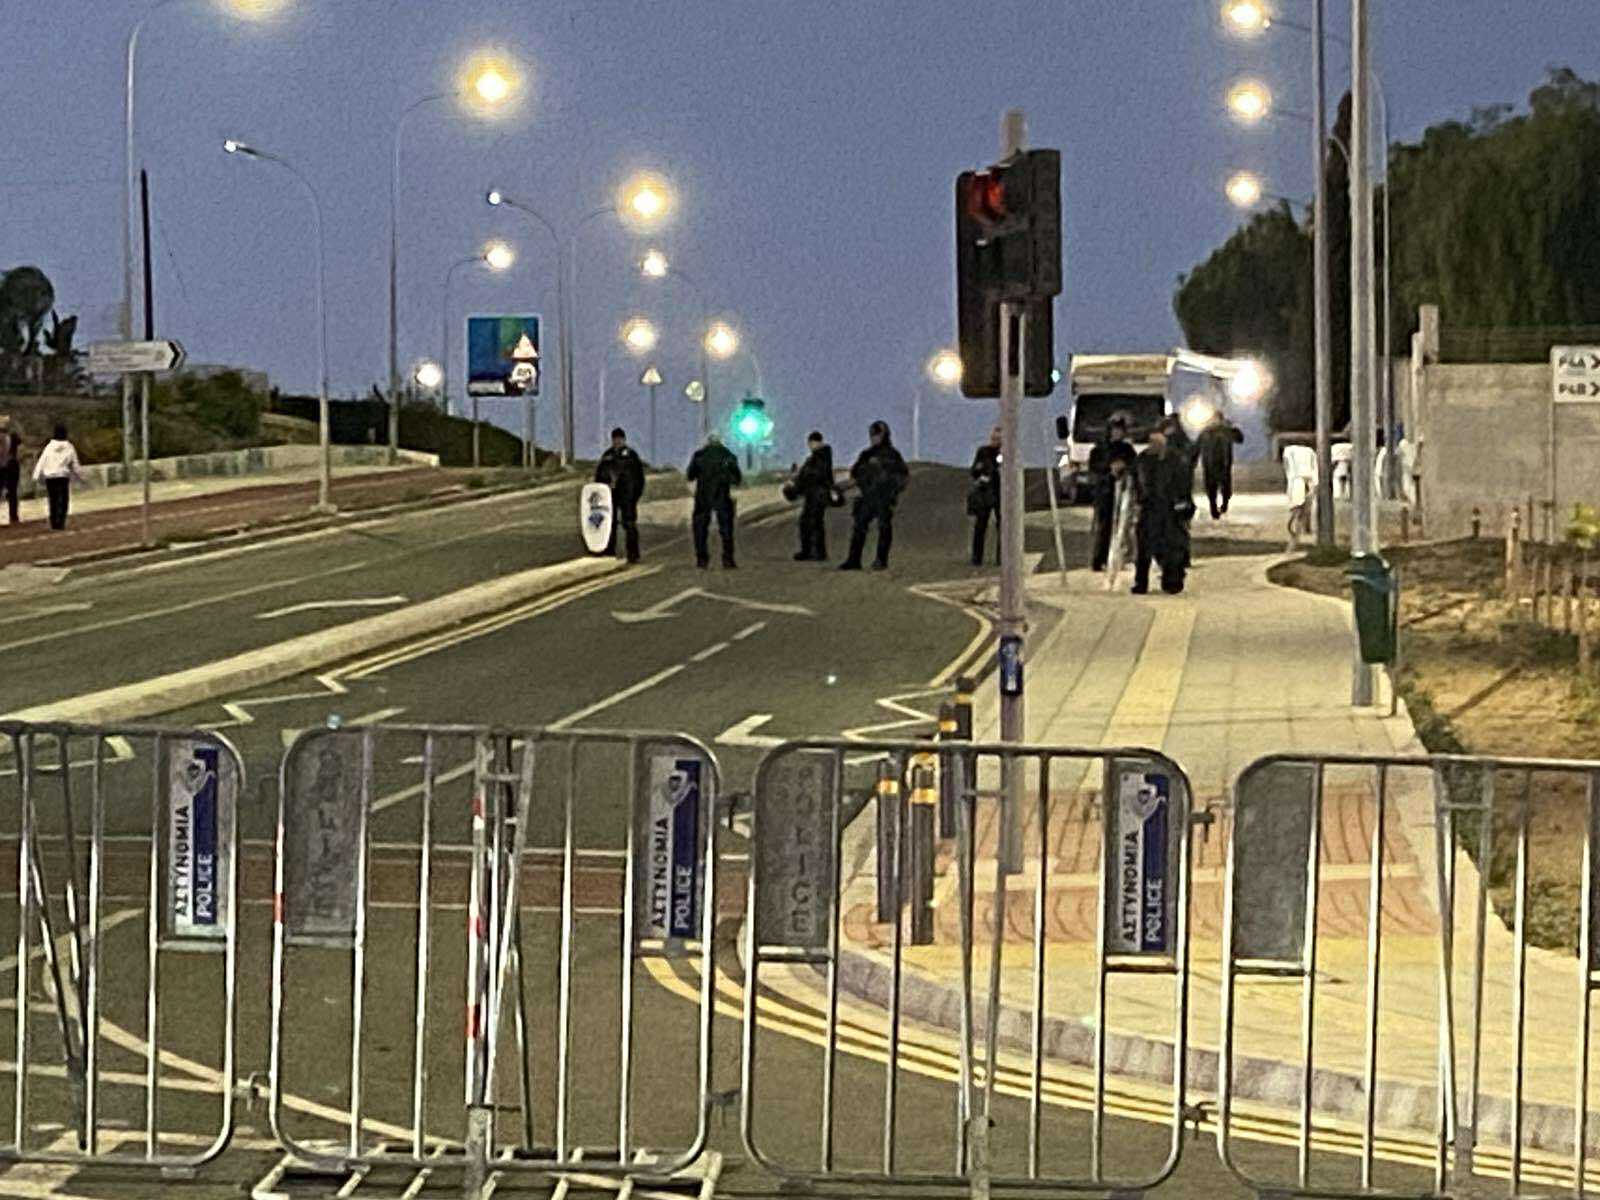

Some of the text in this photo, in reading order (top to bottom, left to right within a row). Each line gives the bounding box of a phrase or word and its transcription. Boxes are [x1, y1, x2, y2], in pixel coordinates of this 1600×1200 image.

[174, 805, 190, 916] ΑΣΤΥΝΟΜΙΑ
[196, 853, 213, 918] POLICE
[651, 817, 669, 928] ΑΣΤΥΝΟΜΙΑ
[674, 864, 693, 929] POLICE
[1122, 830, 1140, 943] ΑΣΤΥΝΟΜΙΑ
[1145, 878, 1163, 942] POLICE
